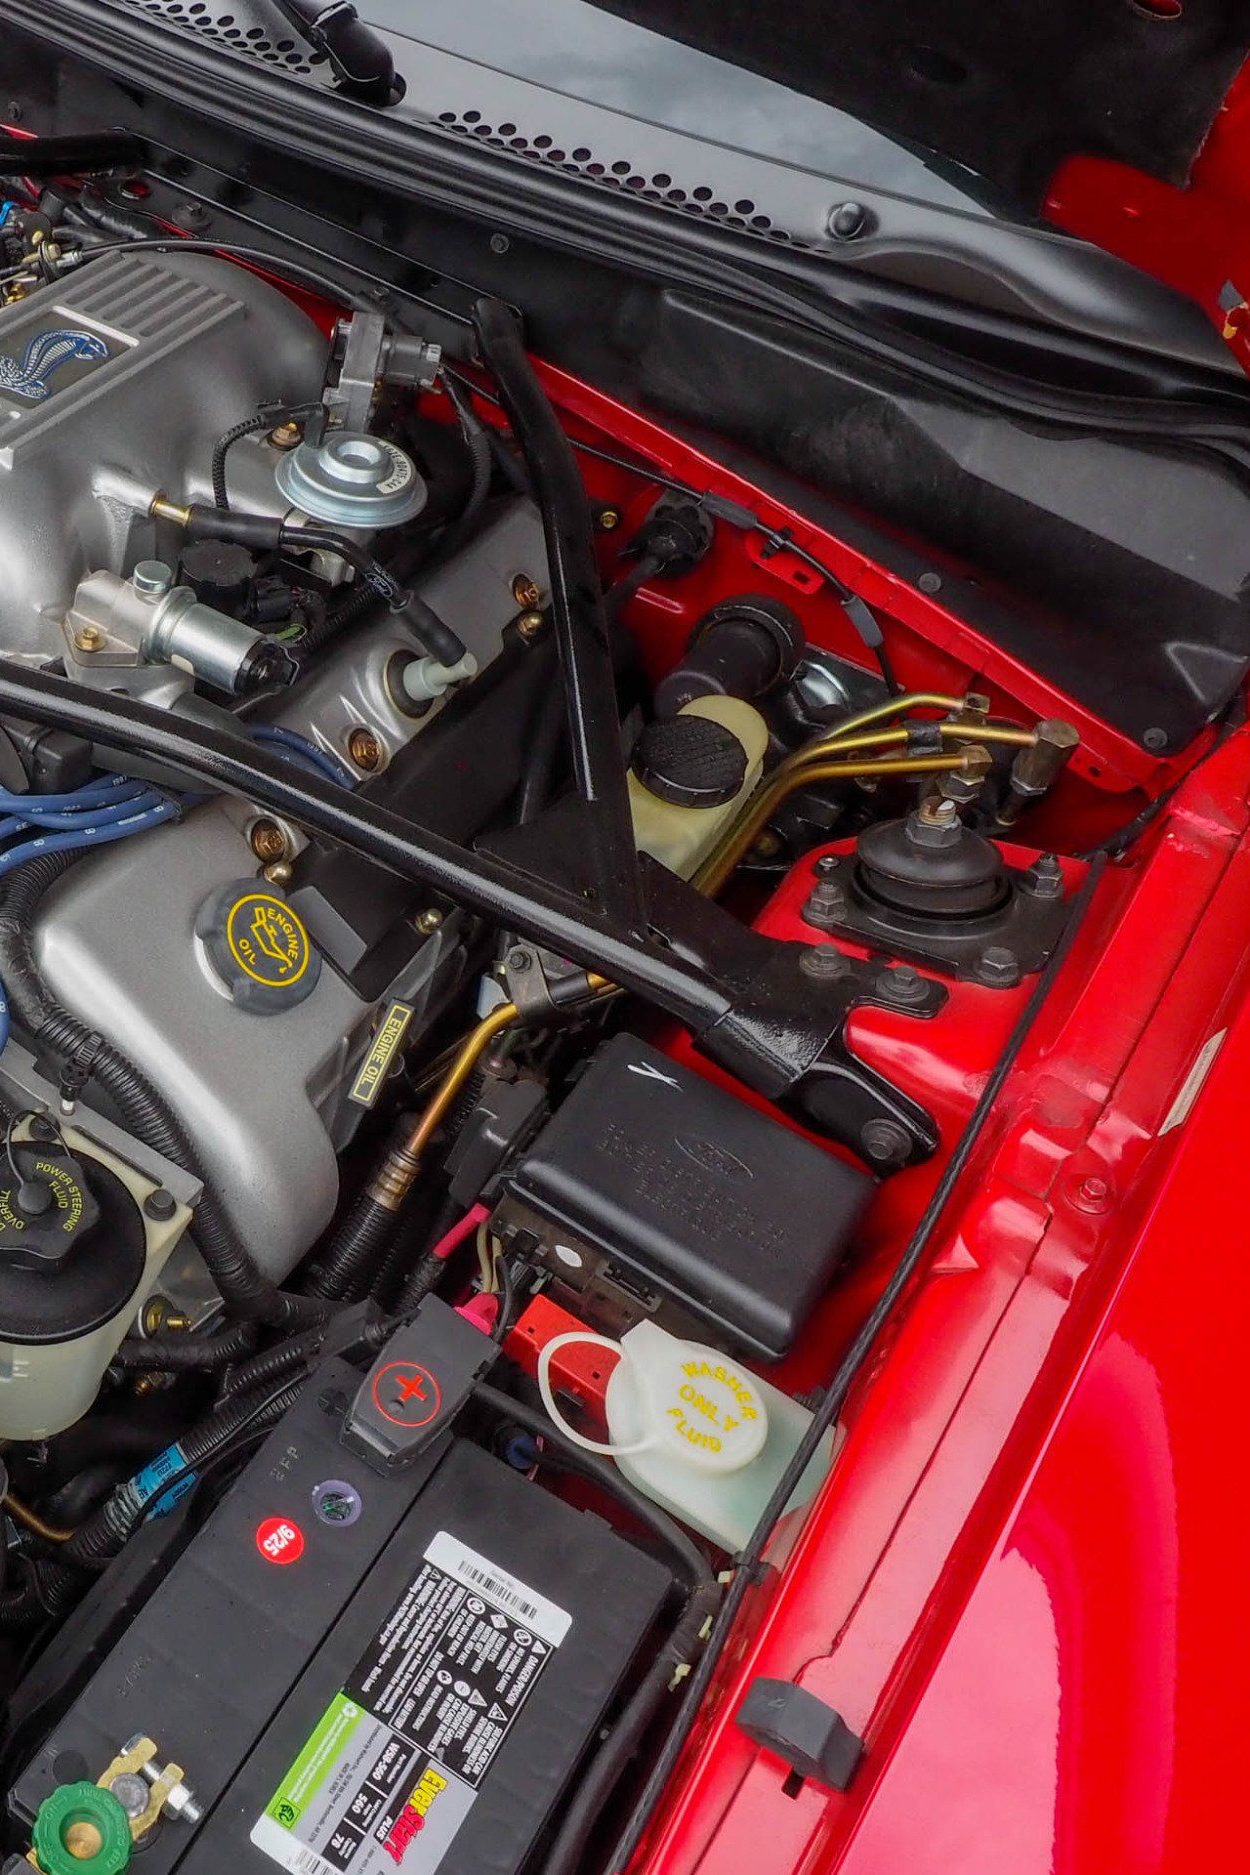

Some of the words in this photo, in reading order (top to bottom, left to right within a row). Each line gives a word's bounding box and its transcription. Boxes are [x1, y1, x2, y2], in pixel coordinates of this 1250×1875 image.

[238, 938, 258, 966] OIL
[266, 907, 299, 960] ENGINE
[373, 1017, 403, 1066] ENGINE
[360, 1065, 380, 1086] OIL
[35, 1162, 74, 1186] POWER
[62, 1184, 84, 1232] STEERING
[48, 1180, 69, 1209] FLUID
[678, 1383, 740, 1433] ONLY
[680, 1360, 758, 1421] WASHER
[666, 1407, 722, 1454] FLUID
[262, 1523, 296, 1557] 9/25
[503, 1654, 539, 1707] DANGER/POISON
[350, 1791, 368, 1815] 560
[380, 1767, 448, 1865] EverStart
[329, 1831, 345, 1850] 78
[374, 1814, 394, 1840] PLUS
